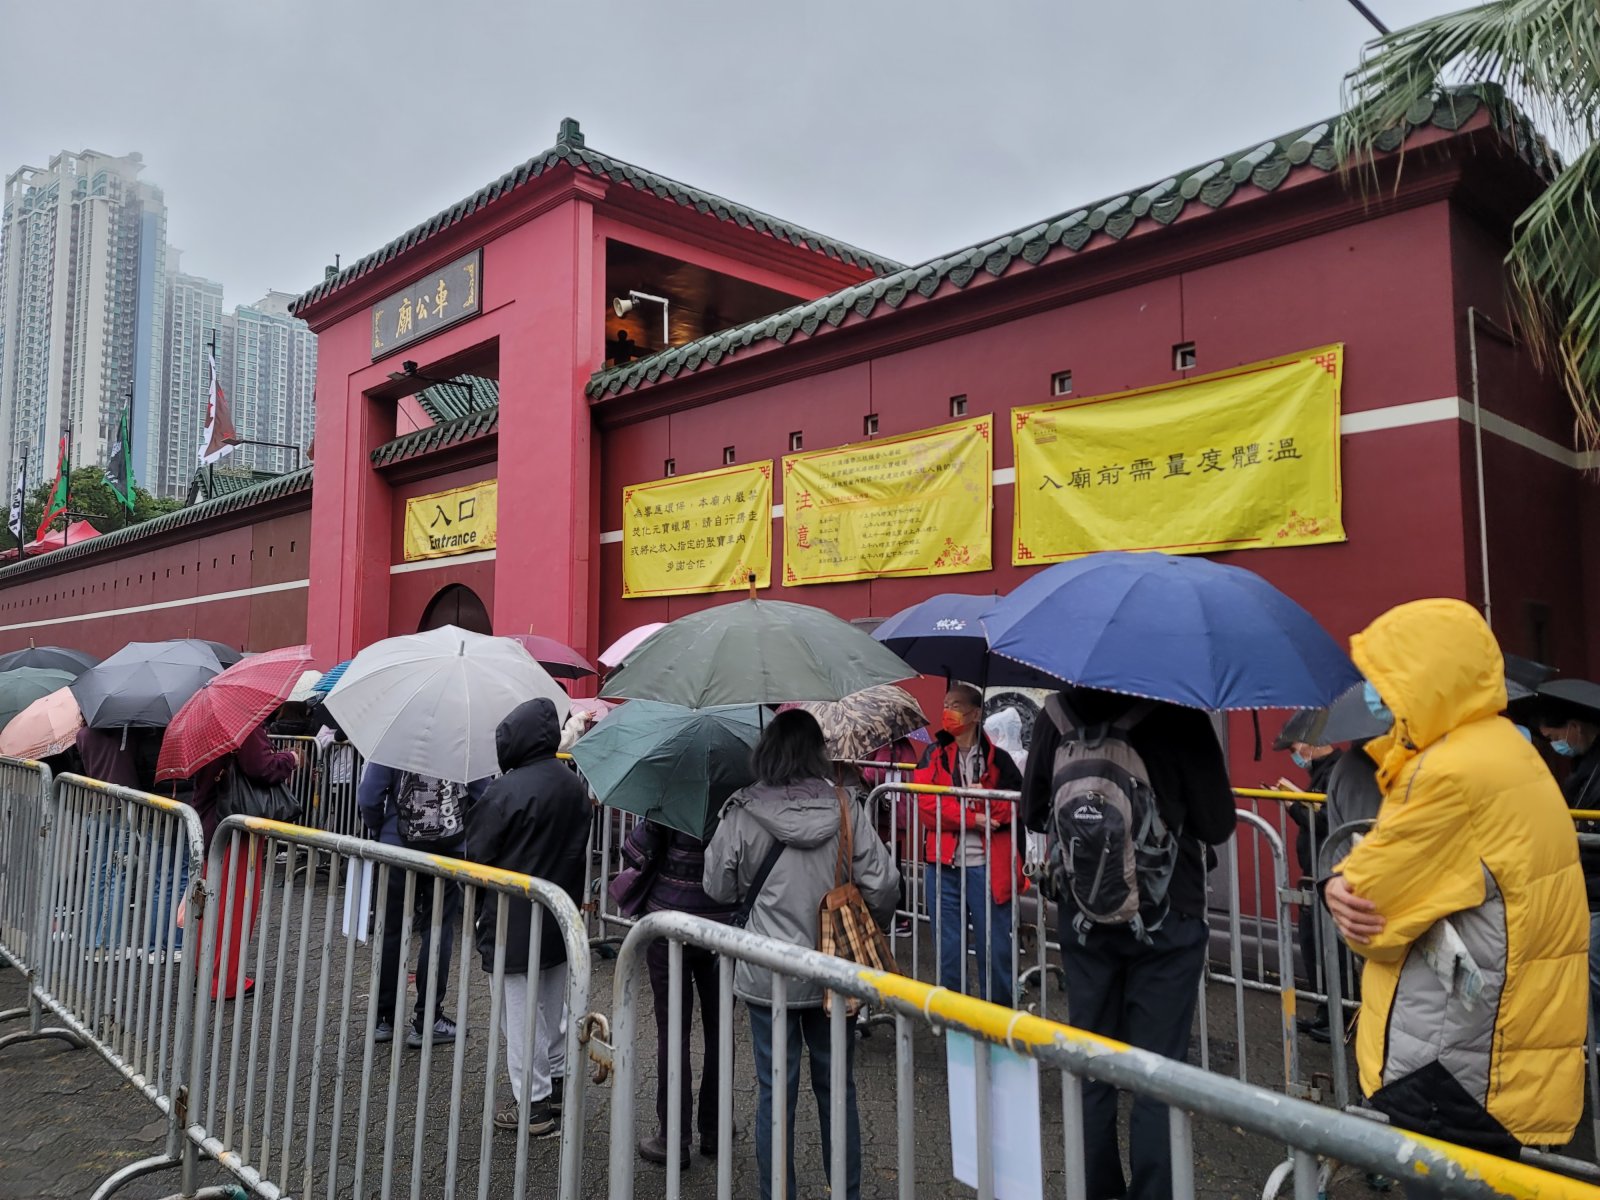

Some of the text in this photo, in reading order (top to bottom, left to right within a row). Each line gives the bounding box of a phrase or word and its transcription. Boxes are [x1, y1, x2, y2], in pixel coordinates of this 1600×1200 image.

[396, 279, 448, 338] 車公廟
[1039, 437, 1303, 490] 入廟前需量度體溫
[431, 497, 476, 528] 入口
[795, 489, 812, 549] 注意
[428, 530, 477, 551] Entrance
